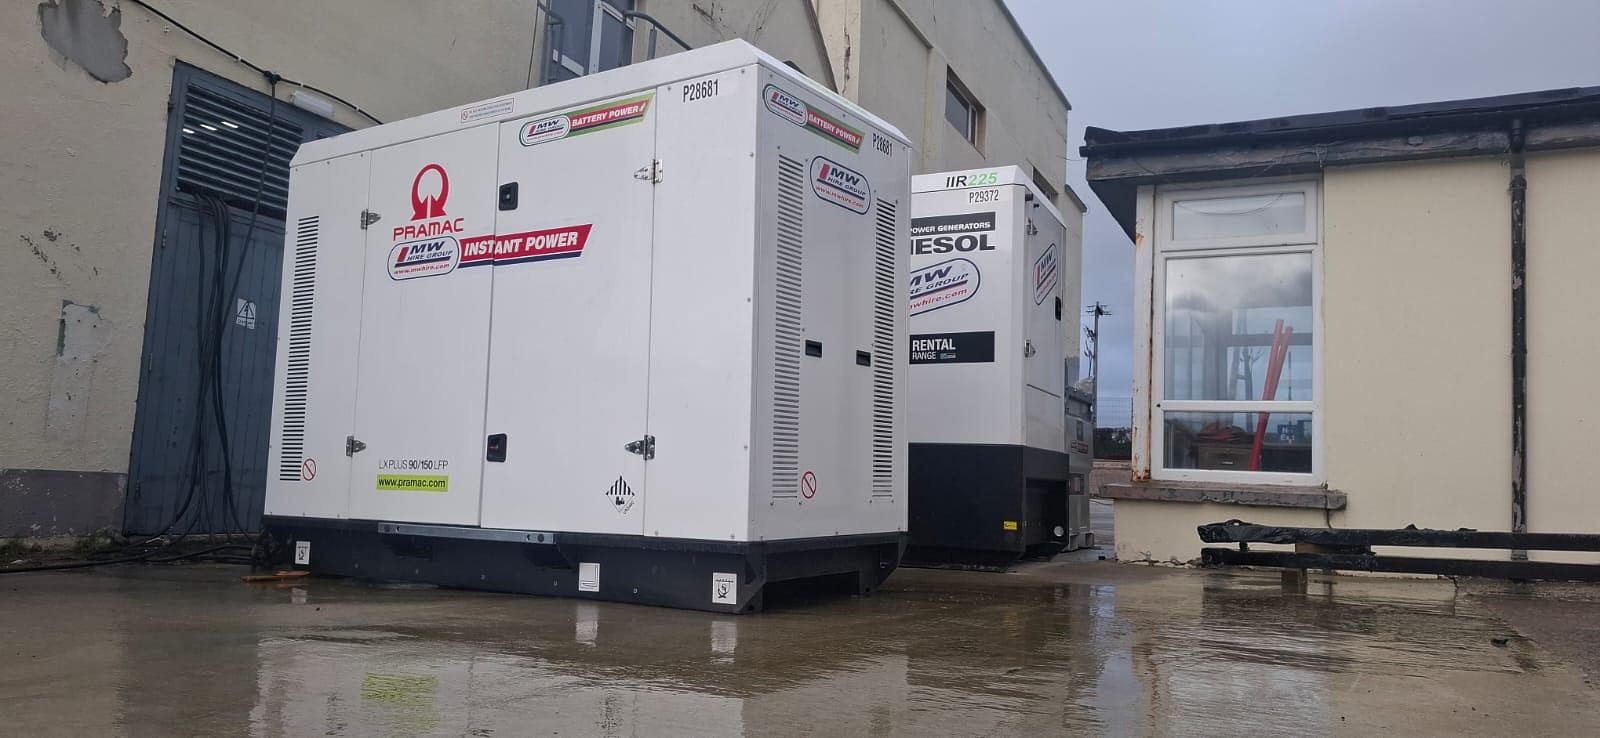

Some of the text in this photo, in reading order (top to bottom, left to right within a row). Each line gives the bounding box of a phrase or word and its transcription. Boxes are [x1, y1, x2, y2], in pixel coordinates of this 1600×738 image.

[682, 78, 719, 103] P28681
[571, 106, 639, 127] BATTERY POWER
[808, 114, 856, 144] BATTERY POWER
[872, 133, 893, 156] P28681
[830, 167, 860, 186] MW
[969, 190, 999, 204] P29372
[393, 217, 465, 242] PRAMAC
[910, 221, 992, 234] OWER GENERATORS
[409, 241, 446, 255] MW
[463, 231, 578, 257] INSTANT POWER
[926, 273, 969, 290] GROUP
[912, 338, 957, 351] RENTAL
[912, 351, 937, 361] RANGE
[408, 460, 433, 470] 90/150
[433, 460, 449, 470] LFP
[378, 479, 446, 488] www.pramac.com
